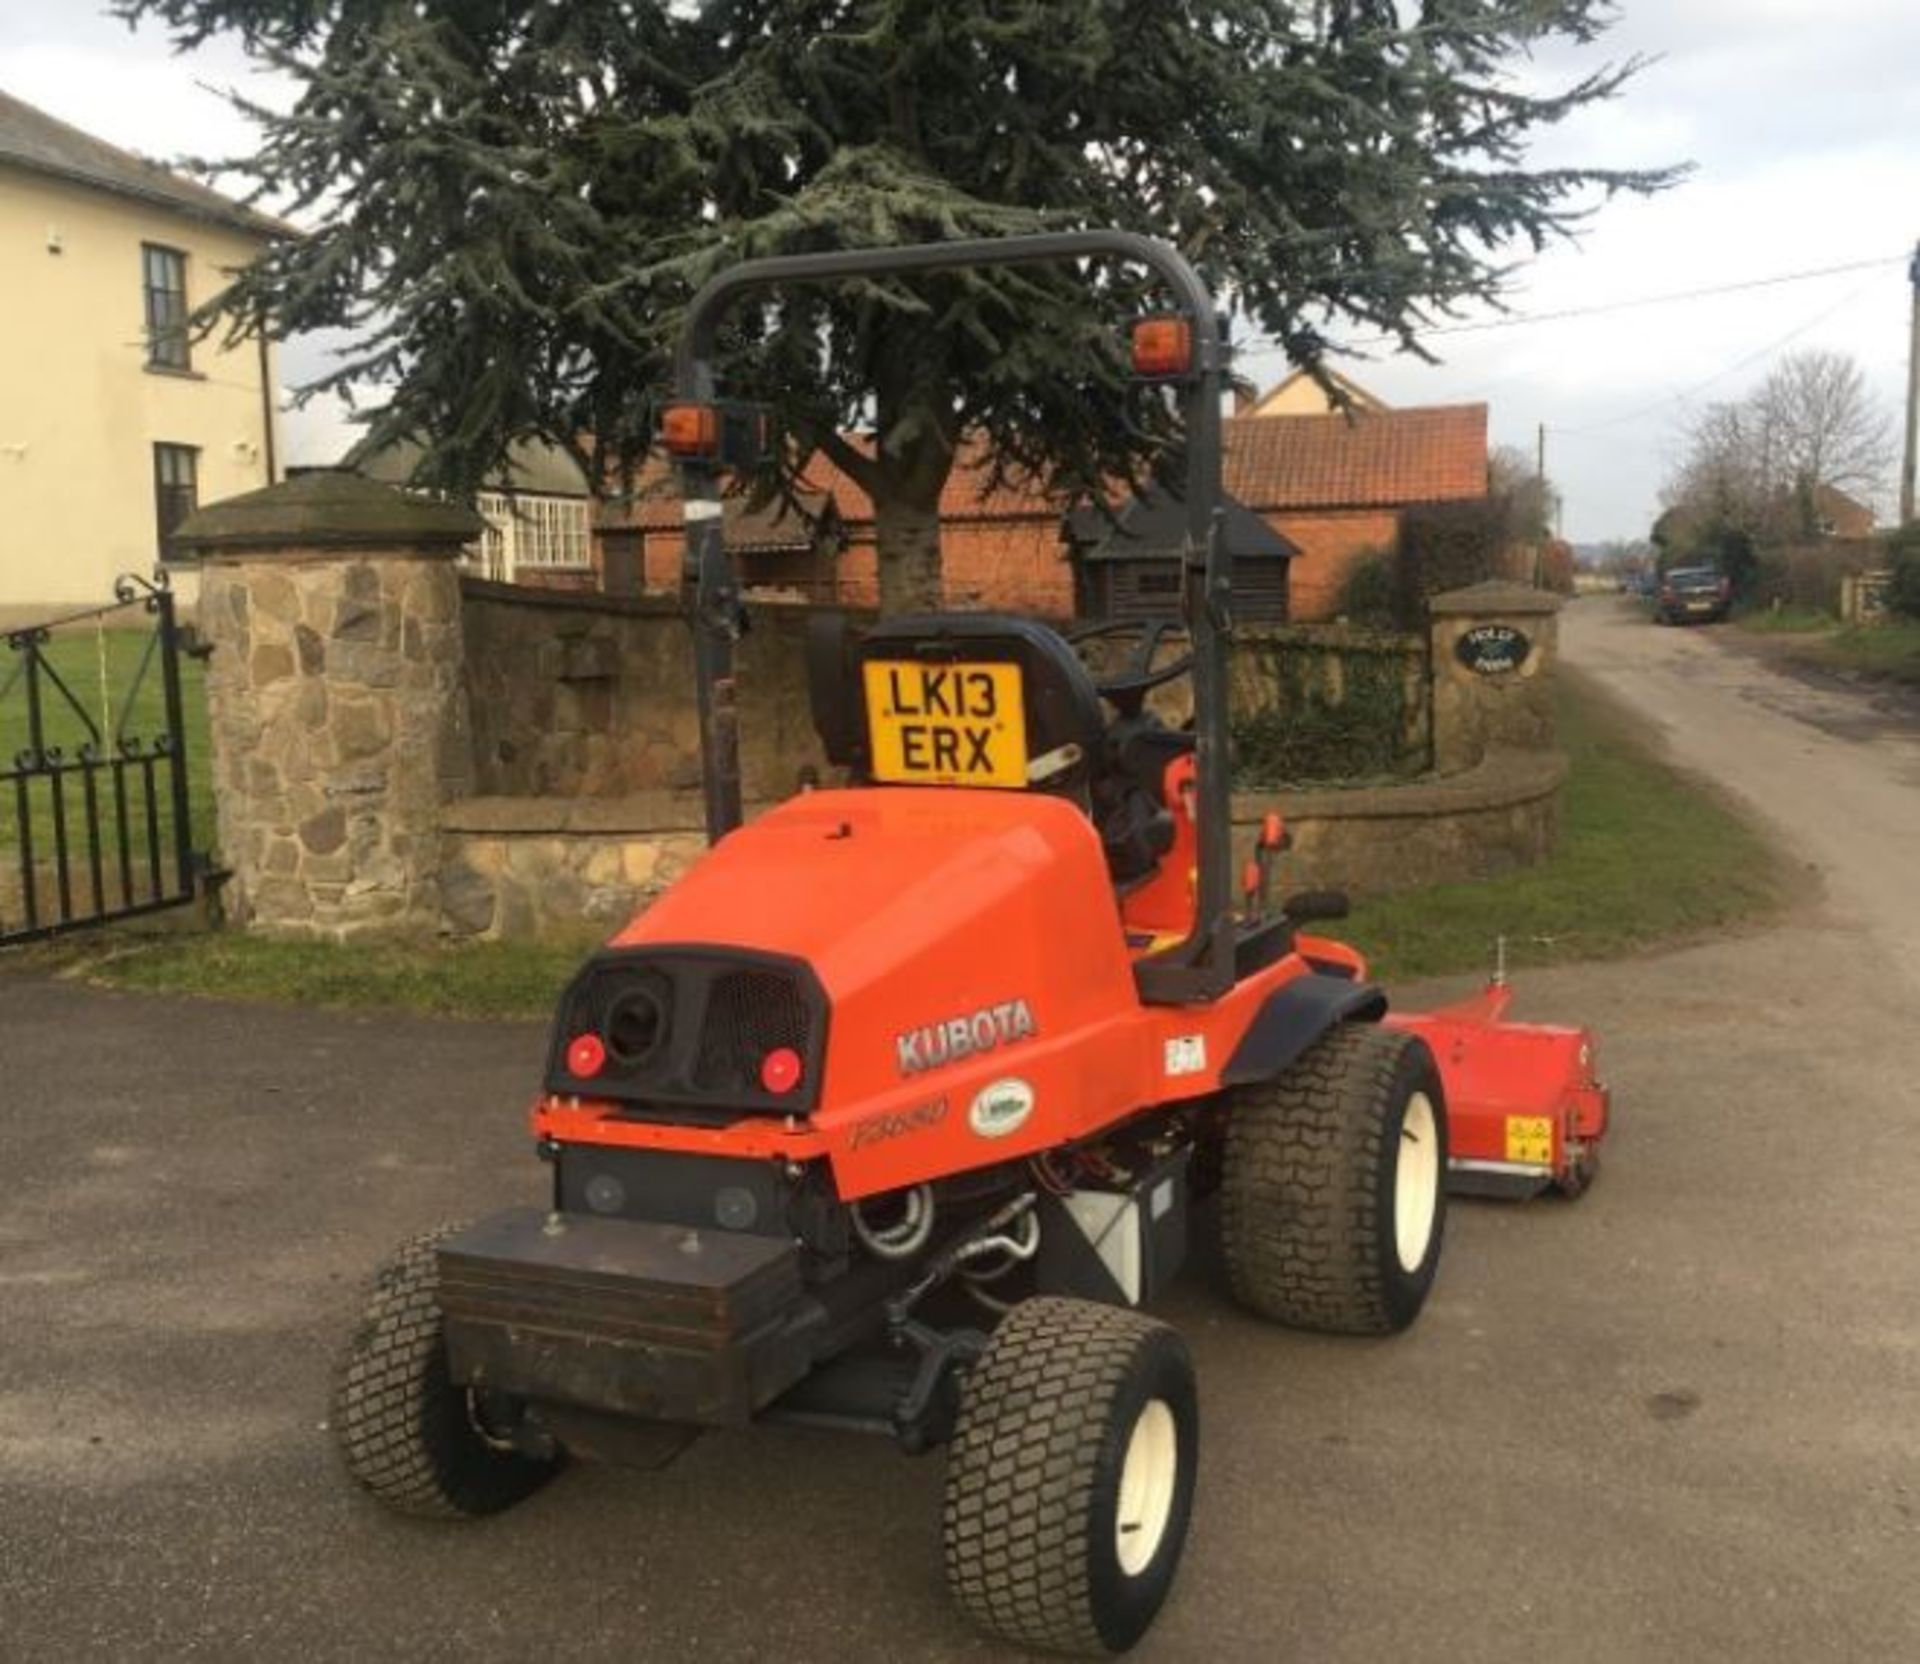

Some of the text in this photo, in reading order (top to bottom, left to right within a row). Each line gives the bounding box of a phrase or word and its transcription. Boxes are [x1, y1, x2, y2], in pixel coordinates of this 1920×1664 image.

[890, 669, 996, 718] LK13
[901, 725, 994, 773] ERX
[896, 999, 1036, 1076] KUBOTA
